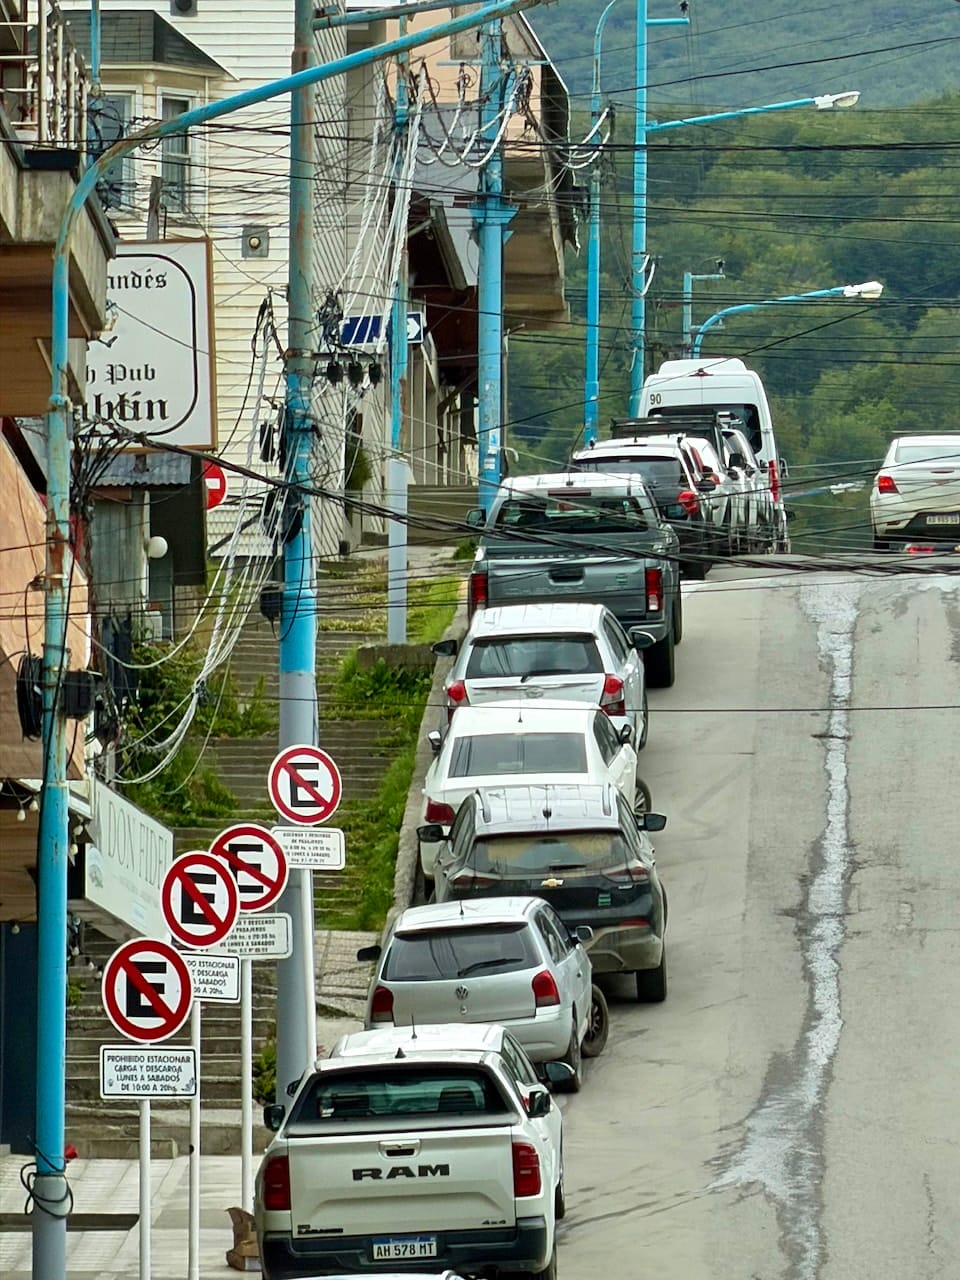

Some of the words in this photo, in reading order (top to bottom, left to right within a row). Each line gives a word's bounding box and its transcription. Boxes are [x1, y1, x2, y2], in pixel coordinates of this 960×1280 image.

[106, 268, 167, 290] andés
[104, 364, 156, 385] Pub
[650, 393, 661, 405] 90
[197, 969, 229, 977] DESCARGA
[198, 978, 227, 986] SABADOS
[107, 1055, 145, 1063] PROHIBIDO
[147, 1055, 191, 1064] ESTACIONAR
[146, 1065, 183, 1073] DESCARGA
[116, 1074, 138, 1082] LUNES
[147, 1074, 180, 1082] SABADOS
[352, 1163, 450, 1181] RAM
[376, 1246, 391, 1257] AH
[394, 1244, 416, 1256] 578
